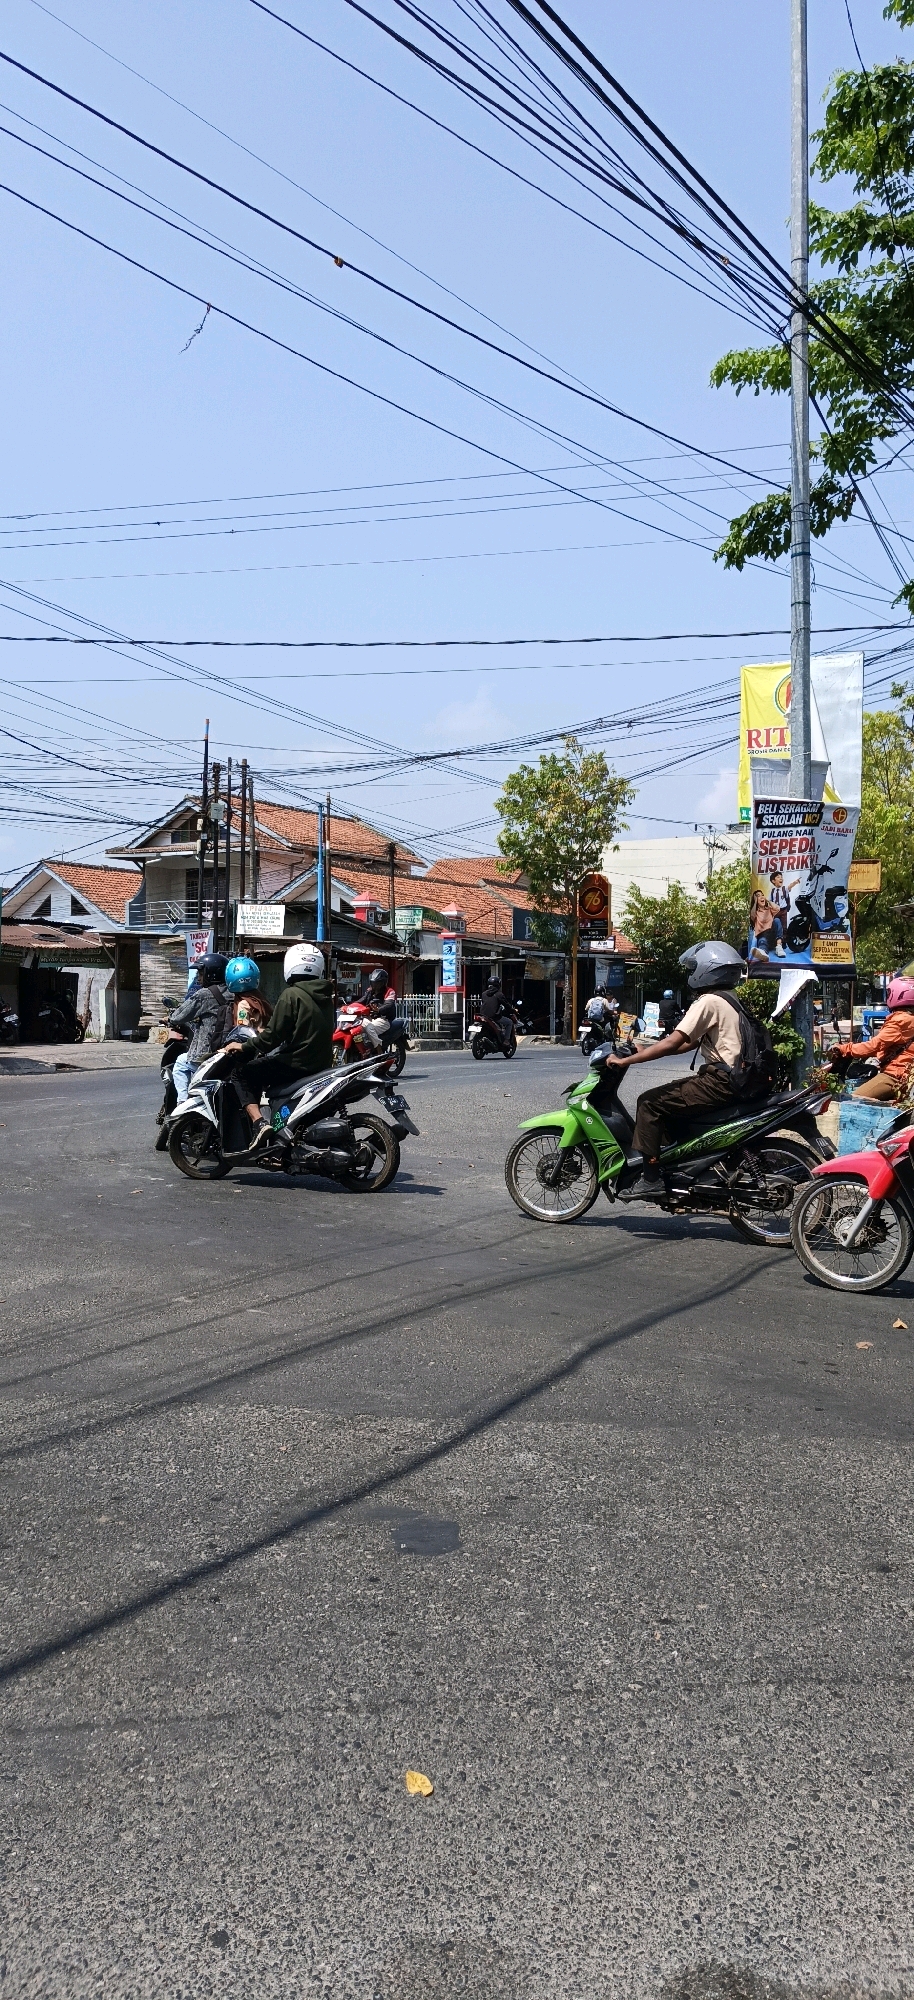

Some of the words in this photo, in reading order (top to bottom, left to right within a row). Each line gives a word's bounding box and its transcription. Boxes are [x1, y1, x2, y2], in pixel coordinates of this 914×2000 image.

[746, 727, 790, 748] RIT
[758, 804, 777, 814] BELI
[779, 803, 820, 813] SERAGAM
[762, 814, 803, 826] SEKOLAH
[762, 830, 793, 838] PULANG
[759, 837, 815, 856] SEPEDA
[584, 890, 601, 910] 76
